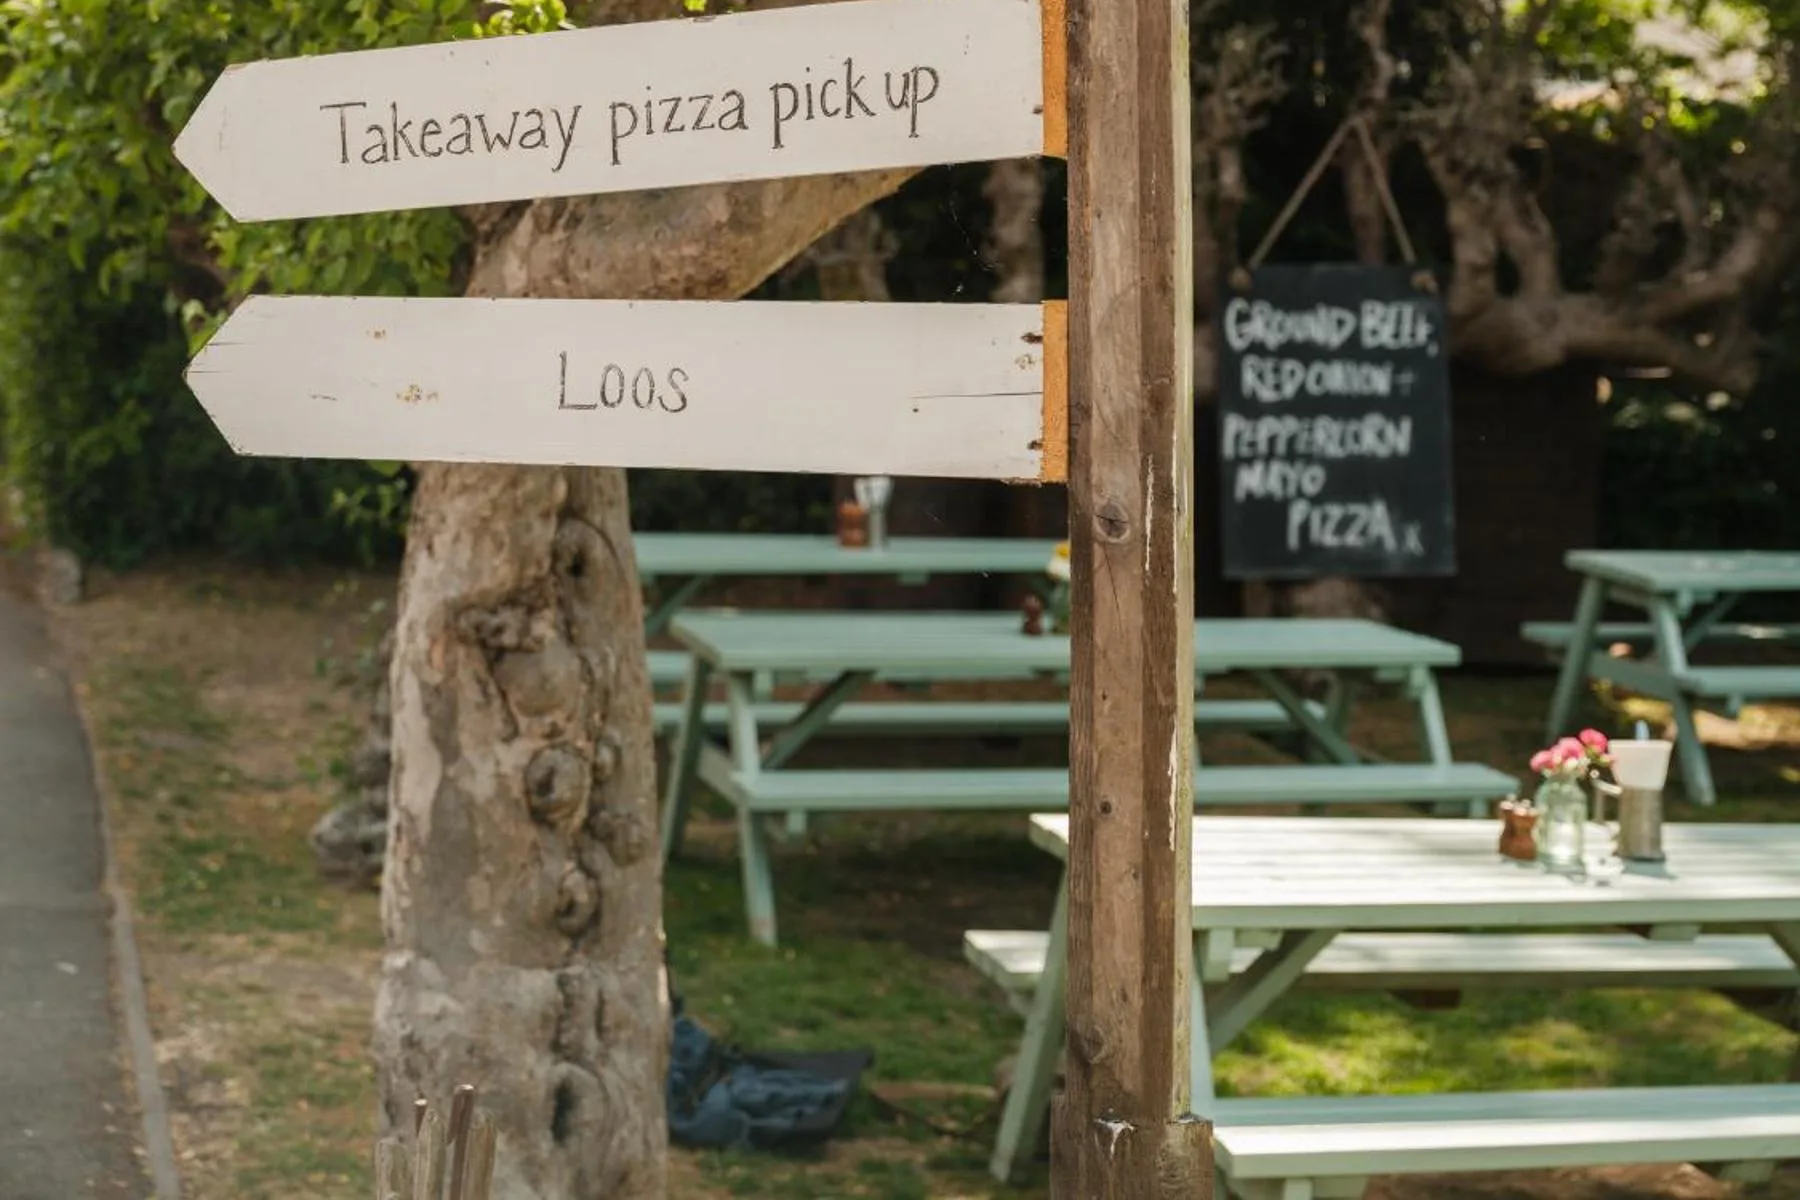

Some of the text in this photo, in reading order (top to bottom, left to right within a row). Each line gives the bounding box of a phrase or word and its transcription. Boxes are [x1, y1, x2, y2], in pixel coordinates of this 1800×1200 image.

[319, 57, 941, 173] Takeaway pizza pick up
[558, 350, 690, 414] Loos
[1287, 499, 1397, 552] PIZZA
